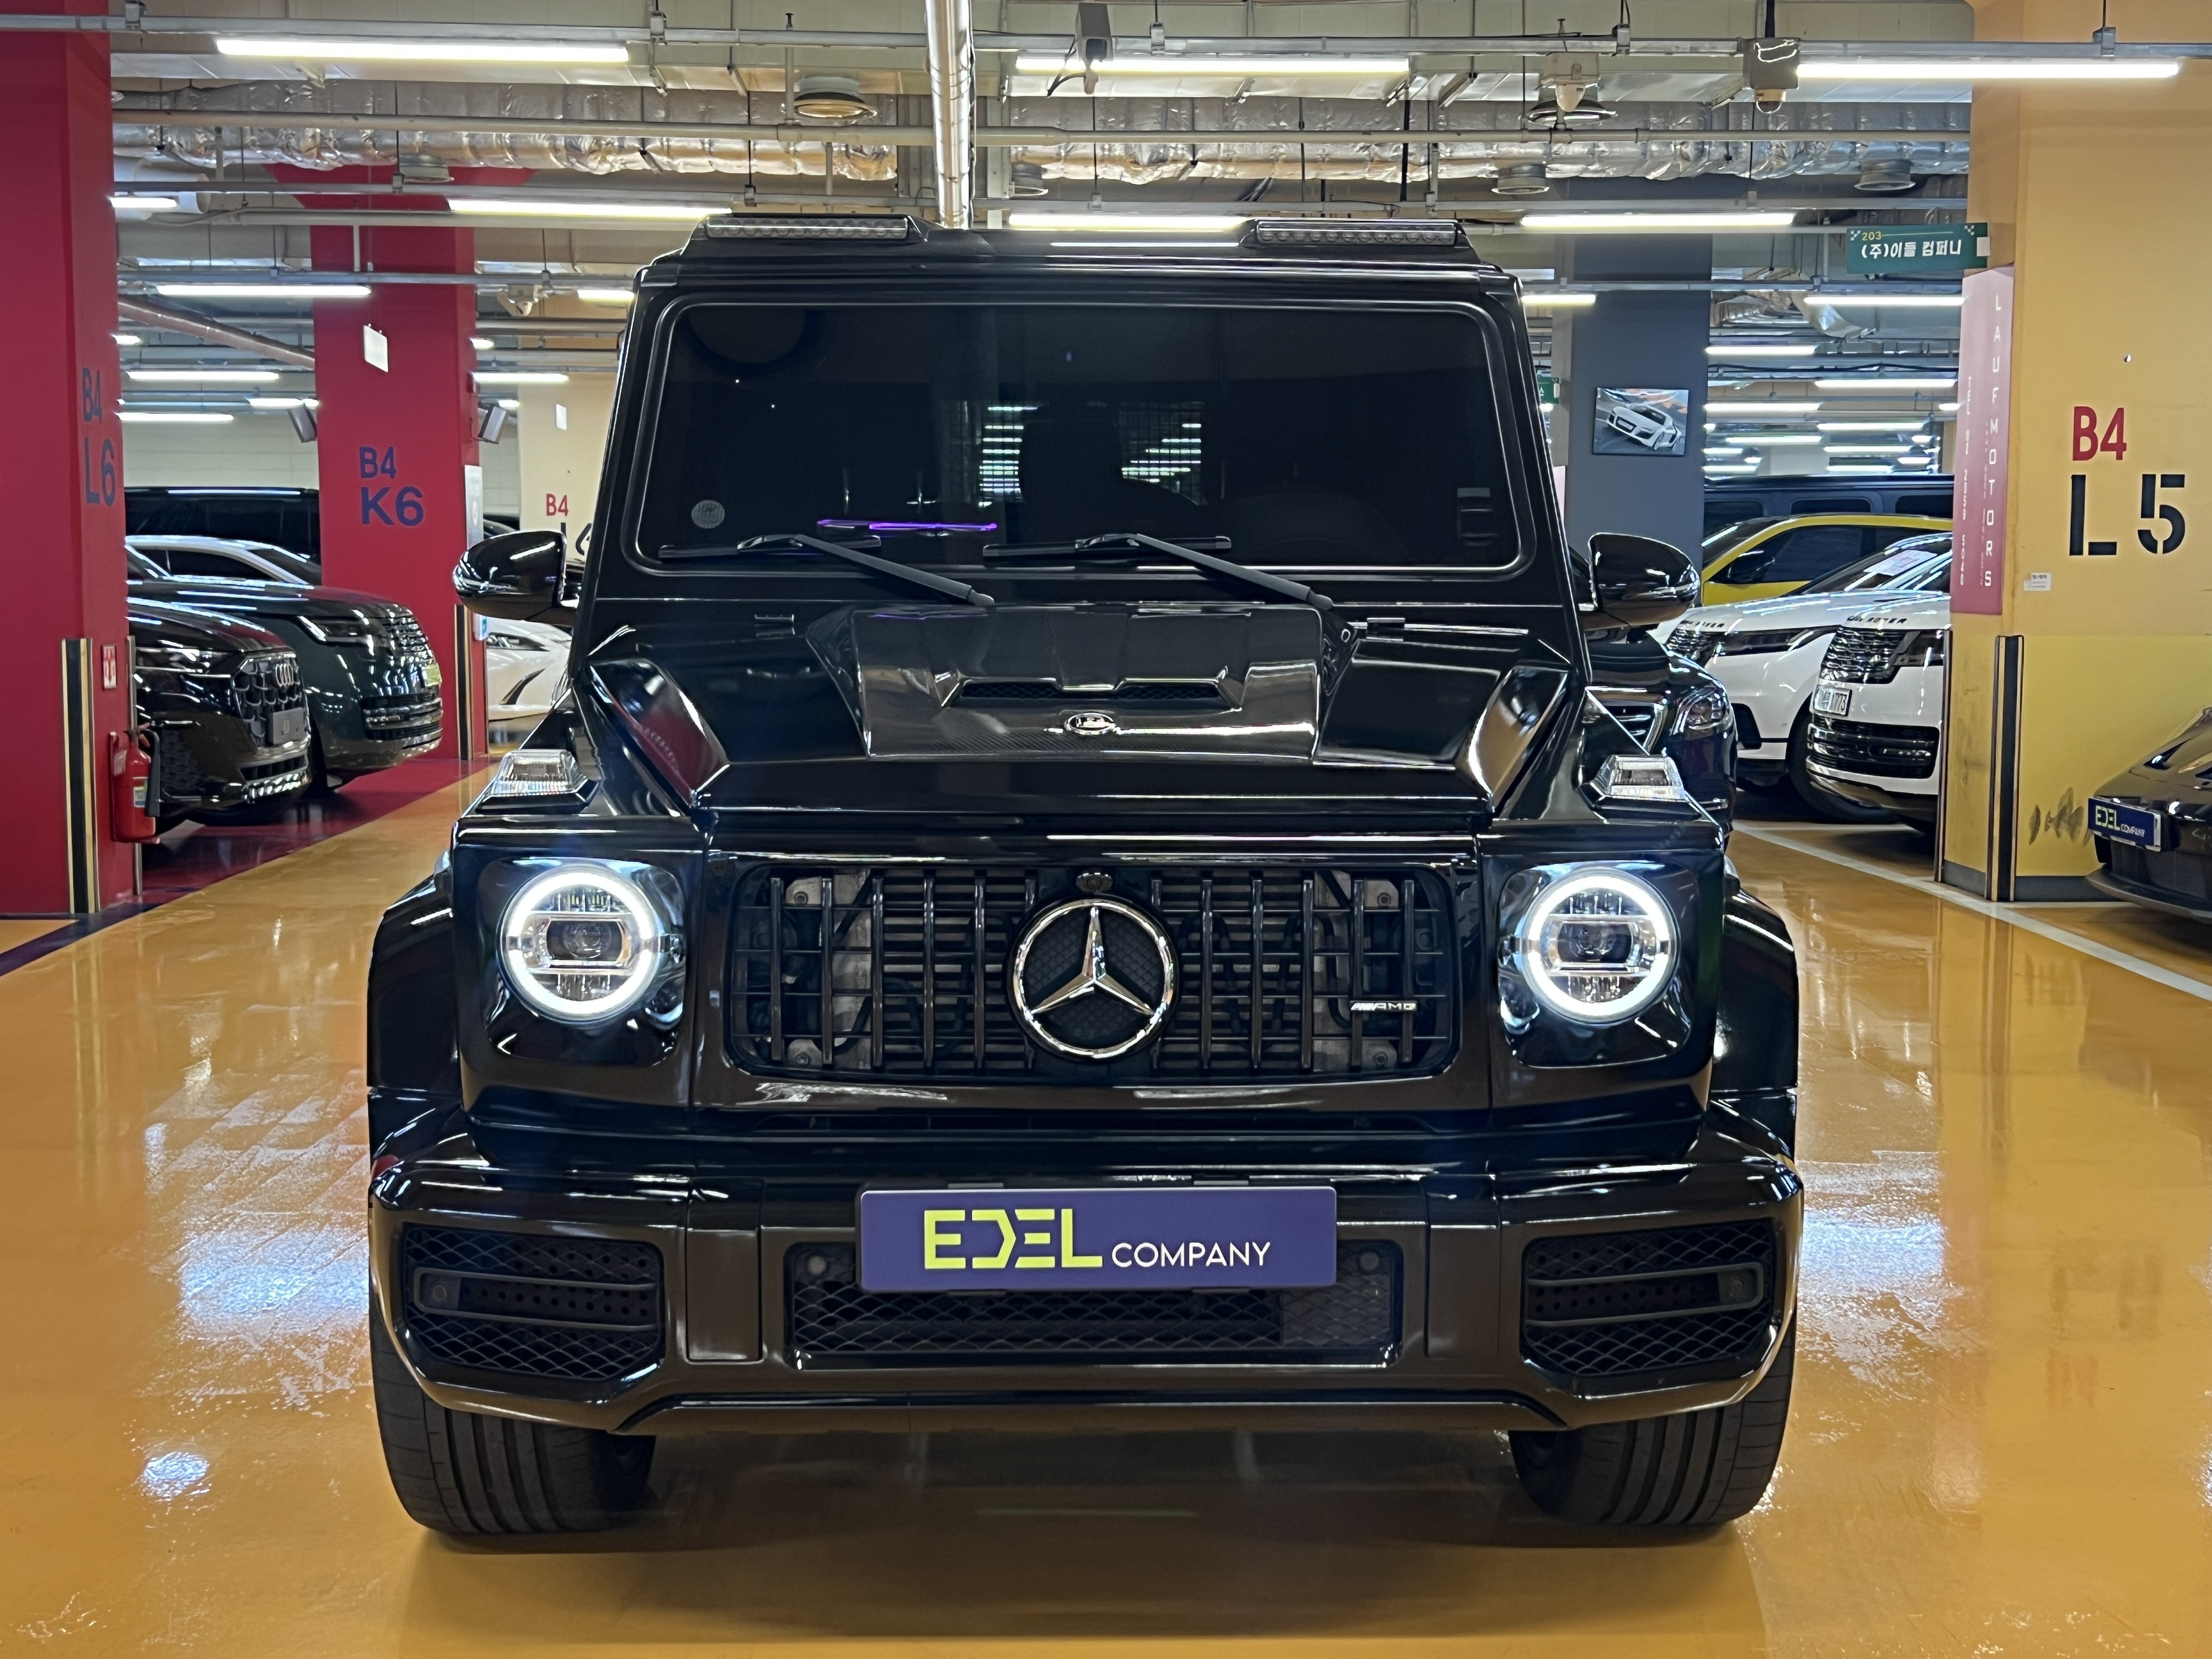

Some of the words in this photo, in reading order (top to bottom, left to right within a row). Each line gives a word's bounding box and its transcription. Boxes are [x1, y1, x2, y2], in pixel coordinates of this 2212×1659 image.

[1861, 231, 1882, 241] 203
[1922, 239, 1962, 257] 컴퍼니
[83, 367, 102, 425] B4
[2072, 406, 2127, 461] B4
[84, 437, 116, 507] L6
[359, 446, 397, 479] B4
[361, 486, 424, 526] K6
[546, 493, 569, 516] B4
[2095, 805, 2120, 831] EDEL
[924, 1209, 1102, 1269] EDEL
[1111, 1242, 1271, 1267] COMPANY
